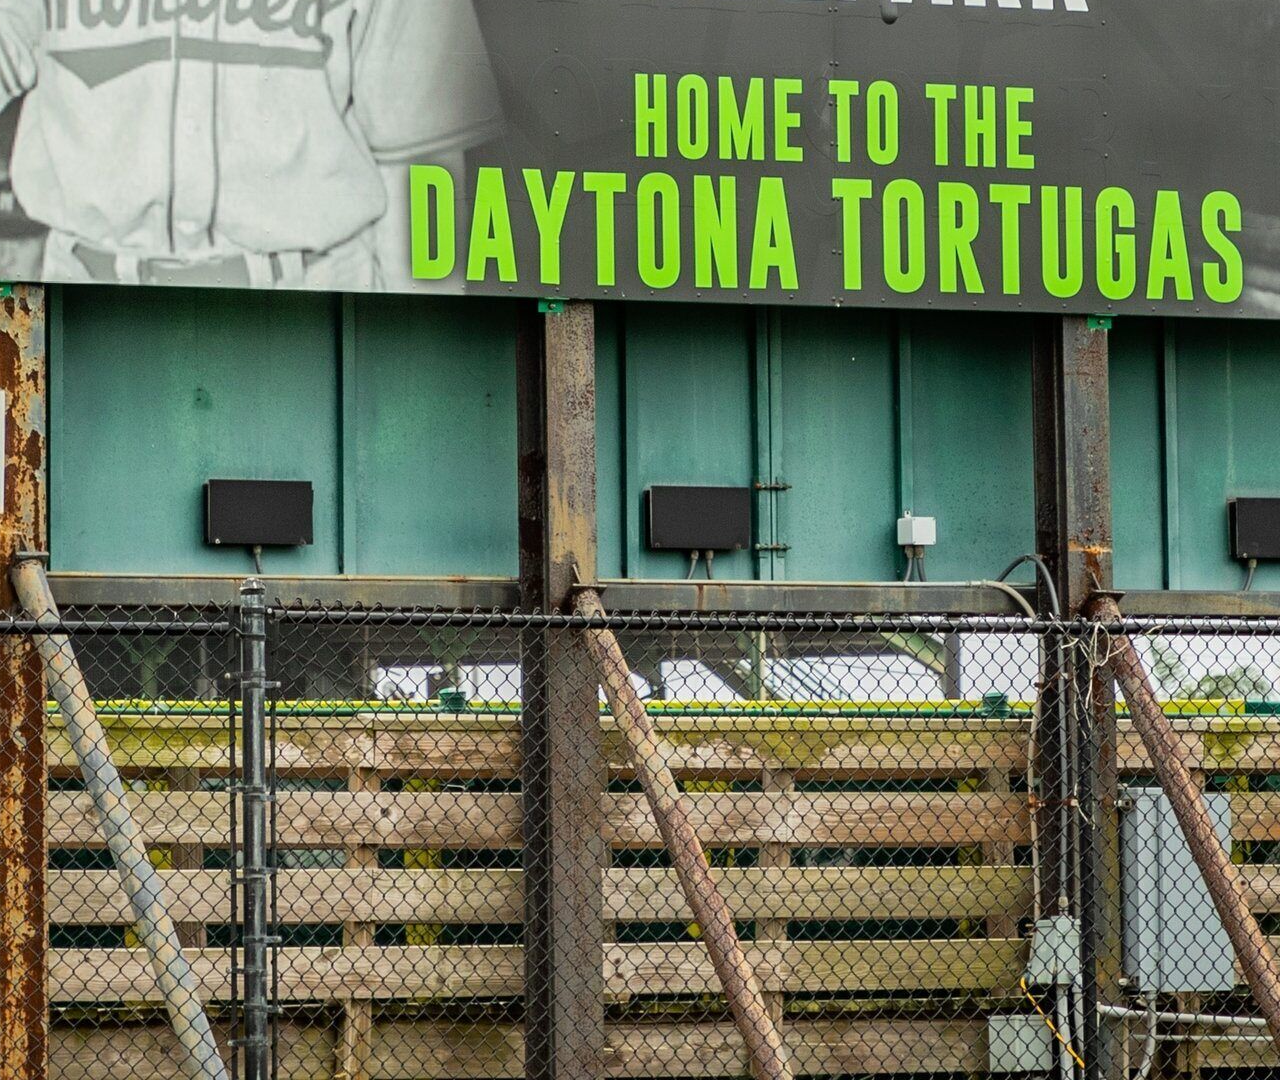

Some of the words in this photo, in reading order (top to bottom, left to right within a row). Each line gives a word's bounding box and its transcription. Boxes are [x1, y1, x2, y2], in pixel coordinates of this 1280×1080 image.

[634, 72, 804, 162] HOME
[827, 79, 899, 166] TO
[925, 83, 1036, 170] THE
[409, 163, 799, 290] DAYTONA
[831, 177, 1244, 304] TORTUGAS
